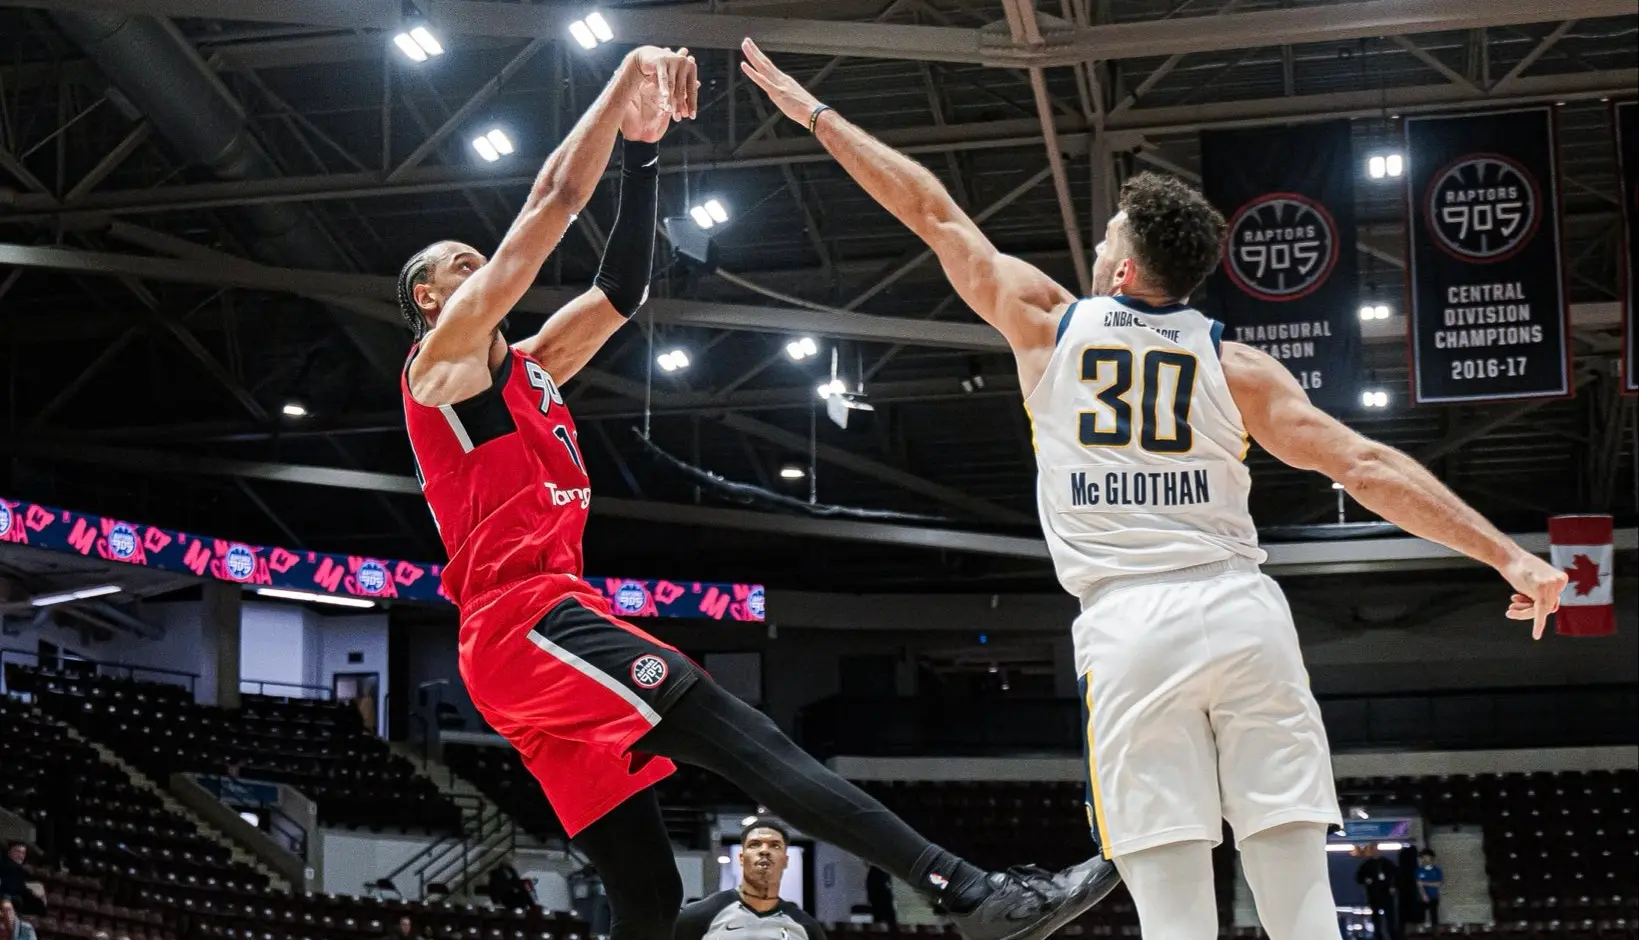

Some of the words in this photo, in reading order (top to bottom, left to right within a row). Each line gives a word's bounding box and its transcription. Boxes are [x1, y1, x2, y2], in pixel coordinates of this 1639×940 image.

[1446, 186, 1518, 203] RAPTORS
[1442, 202, 1523, 239] 905
[1243, 225, 1316, 243] RAPTORS
[1240, 241, 1320, 278] 905
[1447, 281, 1525, 304] CENTRAL
[1113, 311, 1133, 327] NBA
[1444, 304, 1530, 327] DIVISION
[1235, 320, 1332, 342] INAUGURAL
[1434, 325, 1543, 349] CHAMPIONS
[1451, 357, 1528, 380] 2016-17
[1077, 344, 1198, 455] 30
[552, 425, 588, 477] 1
[1071, 472, 1100, 506] Mc
[1105, 469, 1211, 506] GLOTHAN
[640, 661, 662, 683] 905
